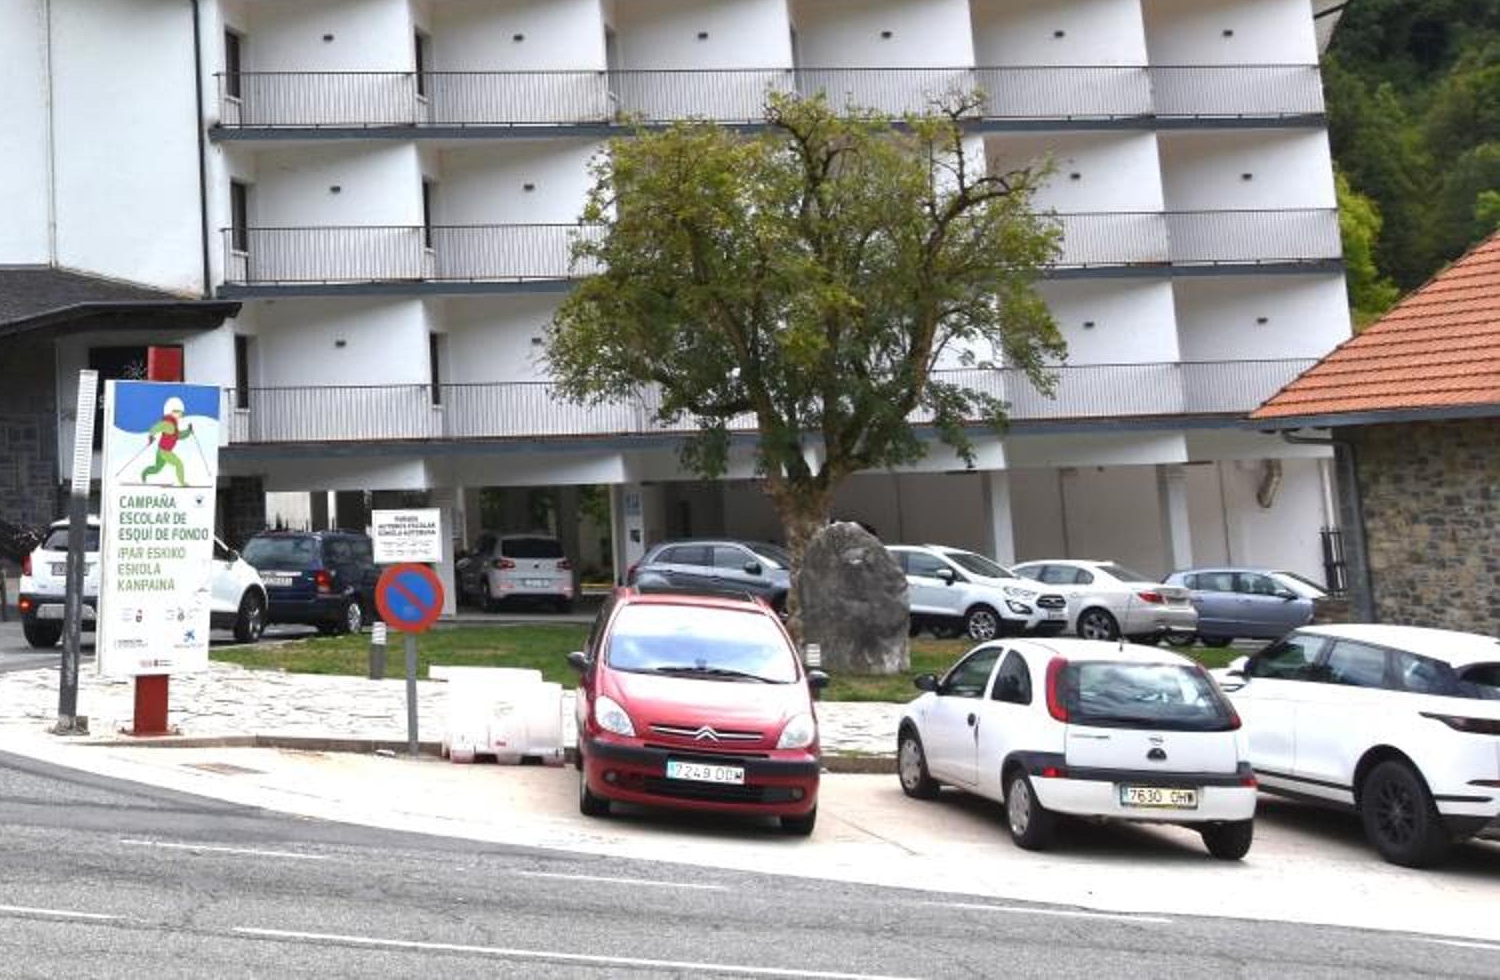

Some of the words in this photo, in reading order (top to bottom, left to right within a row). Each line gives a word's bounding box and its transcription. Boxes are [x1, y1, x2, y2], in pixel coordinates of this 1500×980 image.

[119, 494, 177, 509] CAMPAÑA
[119, 511, 171, 525] ESCOLAR
[173, 512, 187, 525] DE
[118, 525, 153, 543] ESQUÍ
[155, 527, 170, 541] DE
[171, 528, 209, 541] FONDO
[117, 562, 161, 575] ESKOLA
[117, 578, 175, 591] KANPAINA
